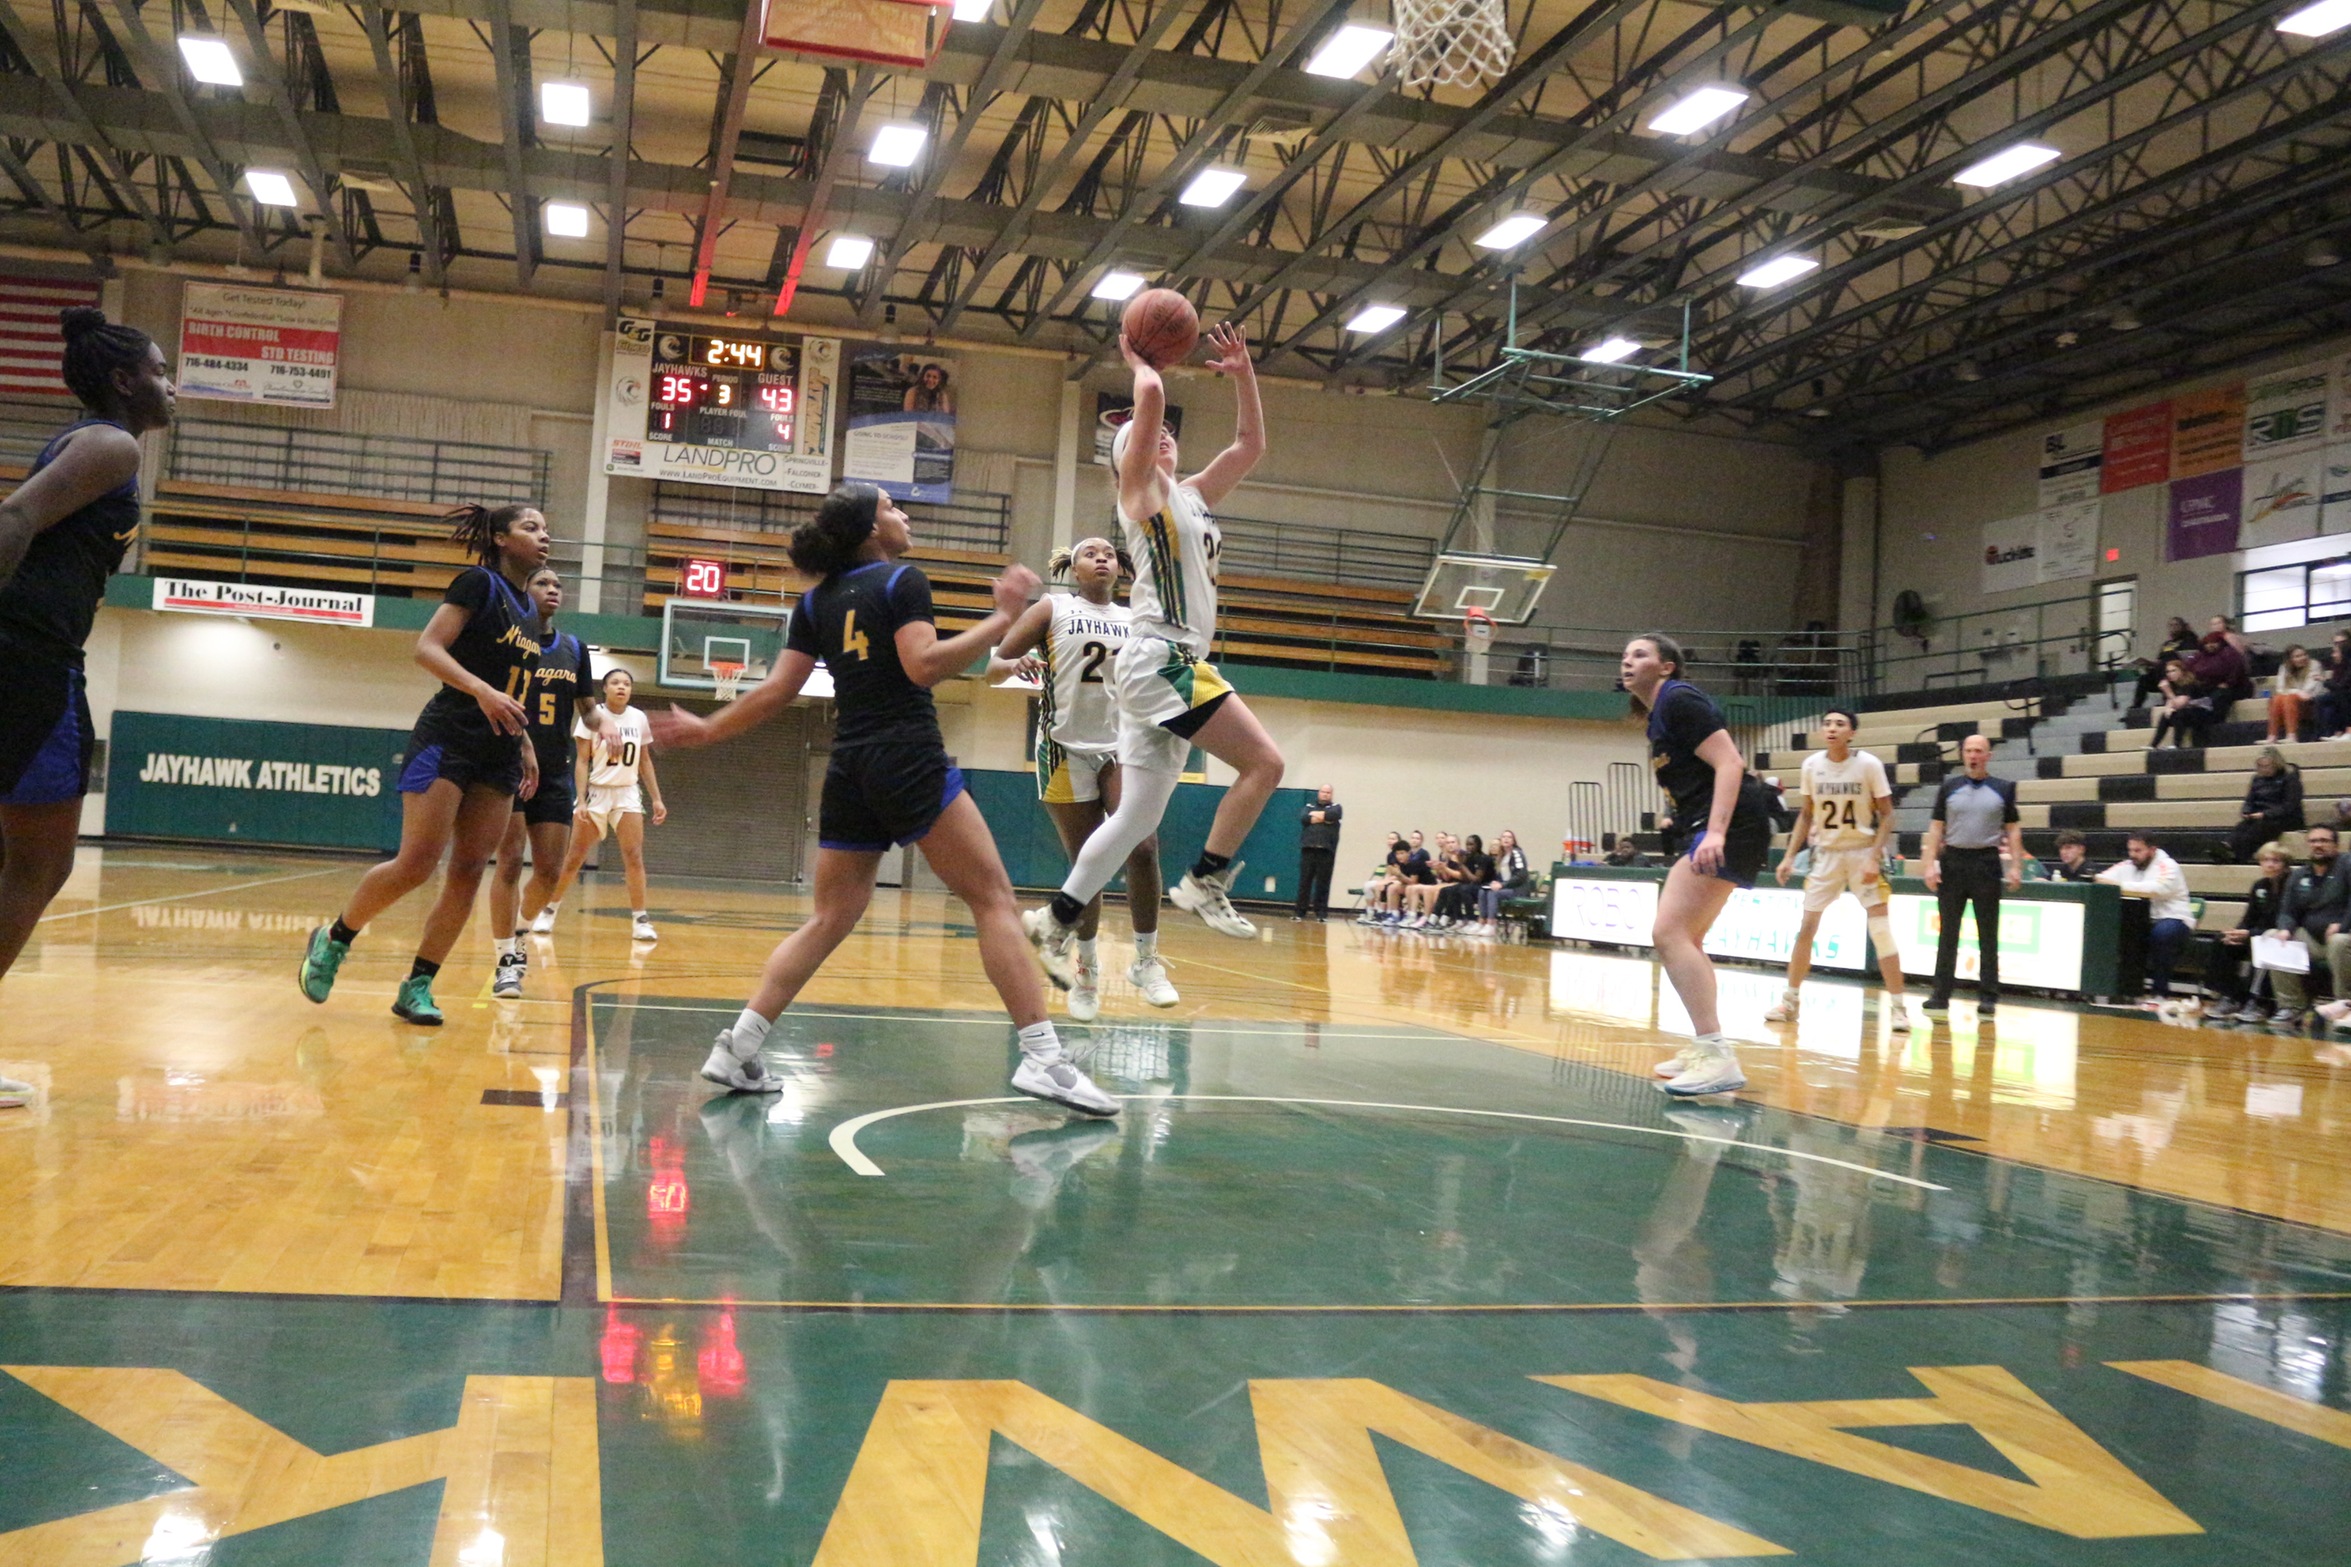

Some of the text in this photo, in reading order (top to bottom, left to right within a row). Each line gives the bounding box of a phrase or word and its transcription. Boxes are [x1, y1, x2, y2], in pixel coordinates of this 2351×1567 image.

[188, 321, 280, 342] BIRTH CONTROL
[261, 345, 335, 364] STD TESTING
[707, 339, 761, 367] 2:44
[270, 364, 332, 379] 716-753-4491
[651, 362, 708, 379] JAYHAWKS
[711, 373, 739, 384] PERIOD
[758, 373, 794, 387] GUEST
[661, 376, 692, 403] 35
[718, 384, 731, 405] 3
[650, 401, 675, 412] FOULS
[761, 388, 793, 412] 43
[663, 412, 672, 430] 1
[699, 406, 748, 419] PLAYER FOUL
[770, 412, 794, 423] FOULS
[648, 432, 673, 442] SCORE
[707, 437, 734, 448] MATCH
[777, 424, 790, 441] 4
[768, 443, 793, 453] SCORE
[663, 444, 777, 476] LANDPRO
[686, 563, 720, 593] 20
[164, 580, 208, 600] The
[216, 584, 363, 613] Post-Journal
[842, 609, 871, 662] 4
[1067, 619, 1130, 639] JAYHAWK
[1080, 641, 1123, 685] 2
[534, 667, 578, 687] agara
[538, 692, 557, 726] 5
[139, 753, 382, 798] JAYHAWK ATHLETICS
[1821, 800, 1857, 830] 24
